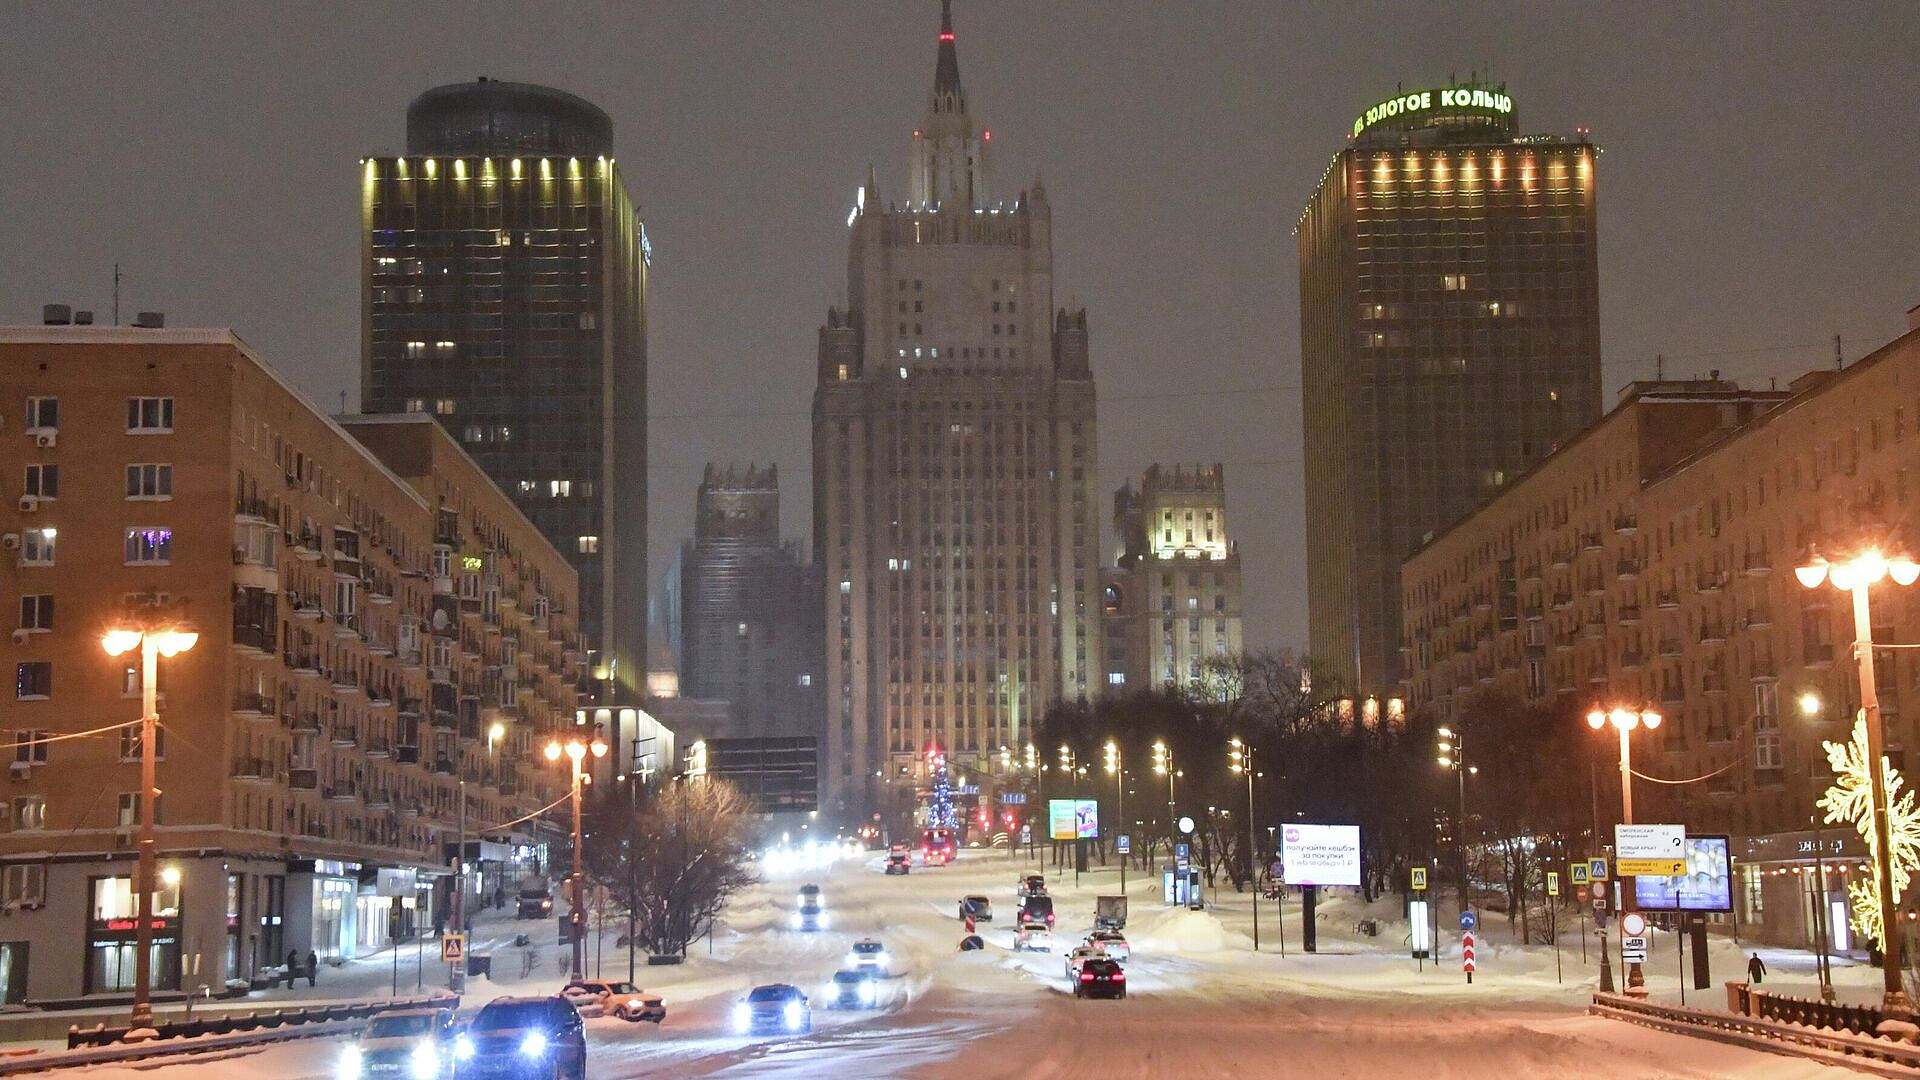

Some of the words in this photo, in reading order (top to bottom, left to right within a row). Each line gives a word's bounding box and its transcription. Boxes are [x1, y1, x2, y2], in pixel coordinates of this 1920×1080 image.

[1366, 93, 1431, 126] ЗОЛОТОЕ
[1441, 90, 1512, 113] КОЛЬЦО
[1287, 831, 1299, 839] wb
[1286, 844, 1327, 852] получайте
